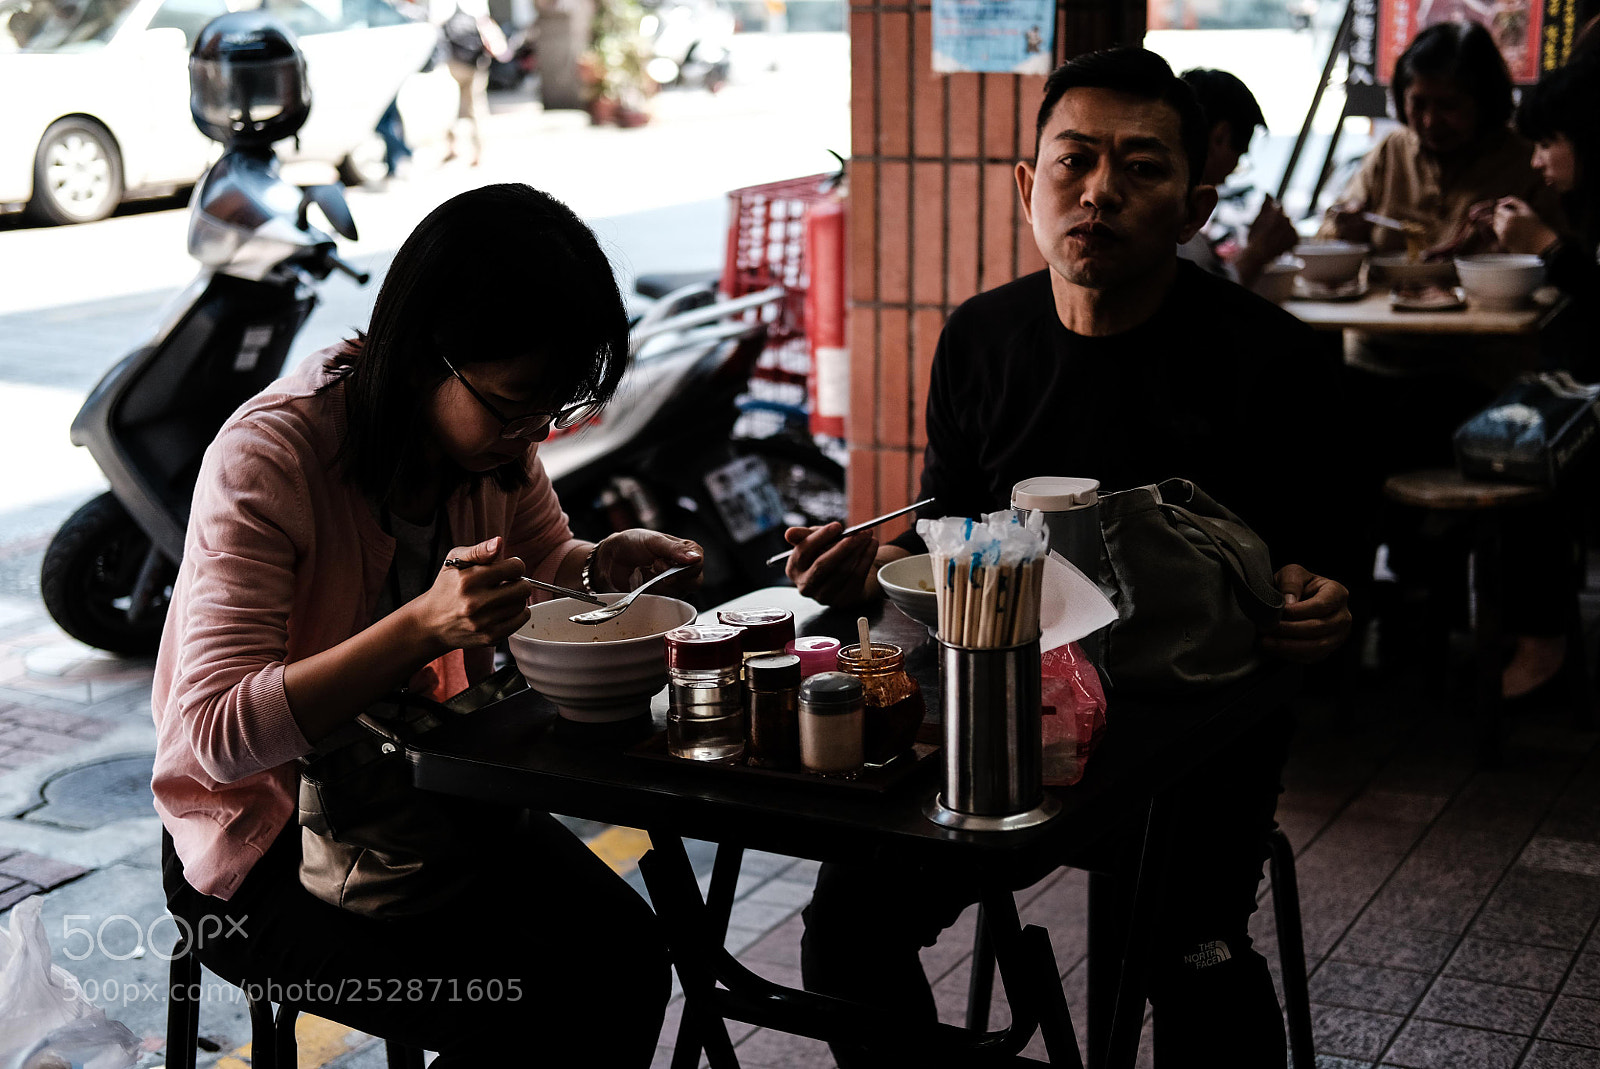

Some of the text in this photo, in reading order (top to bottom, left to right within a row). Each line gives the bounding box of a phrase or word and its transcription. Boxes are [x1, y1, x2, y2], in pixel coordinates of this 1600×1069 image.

[1199, 941, 1215, 951] THE
[1184, 950, 1216, 964] NORTH
[1196, 956, 1217, 970] FACE
